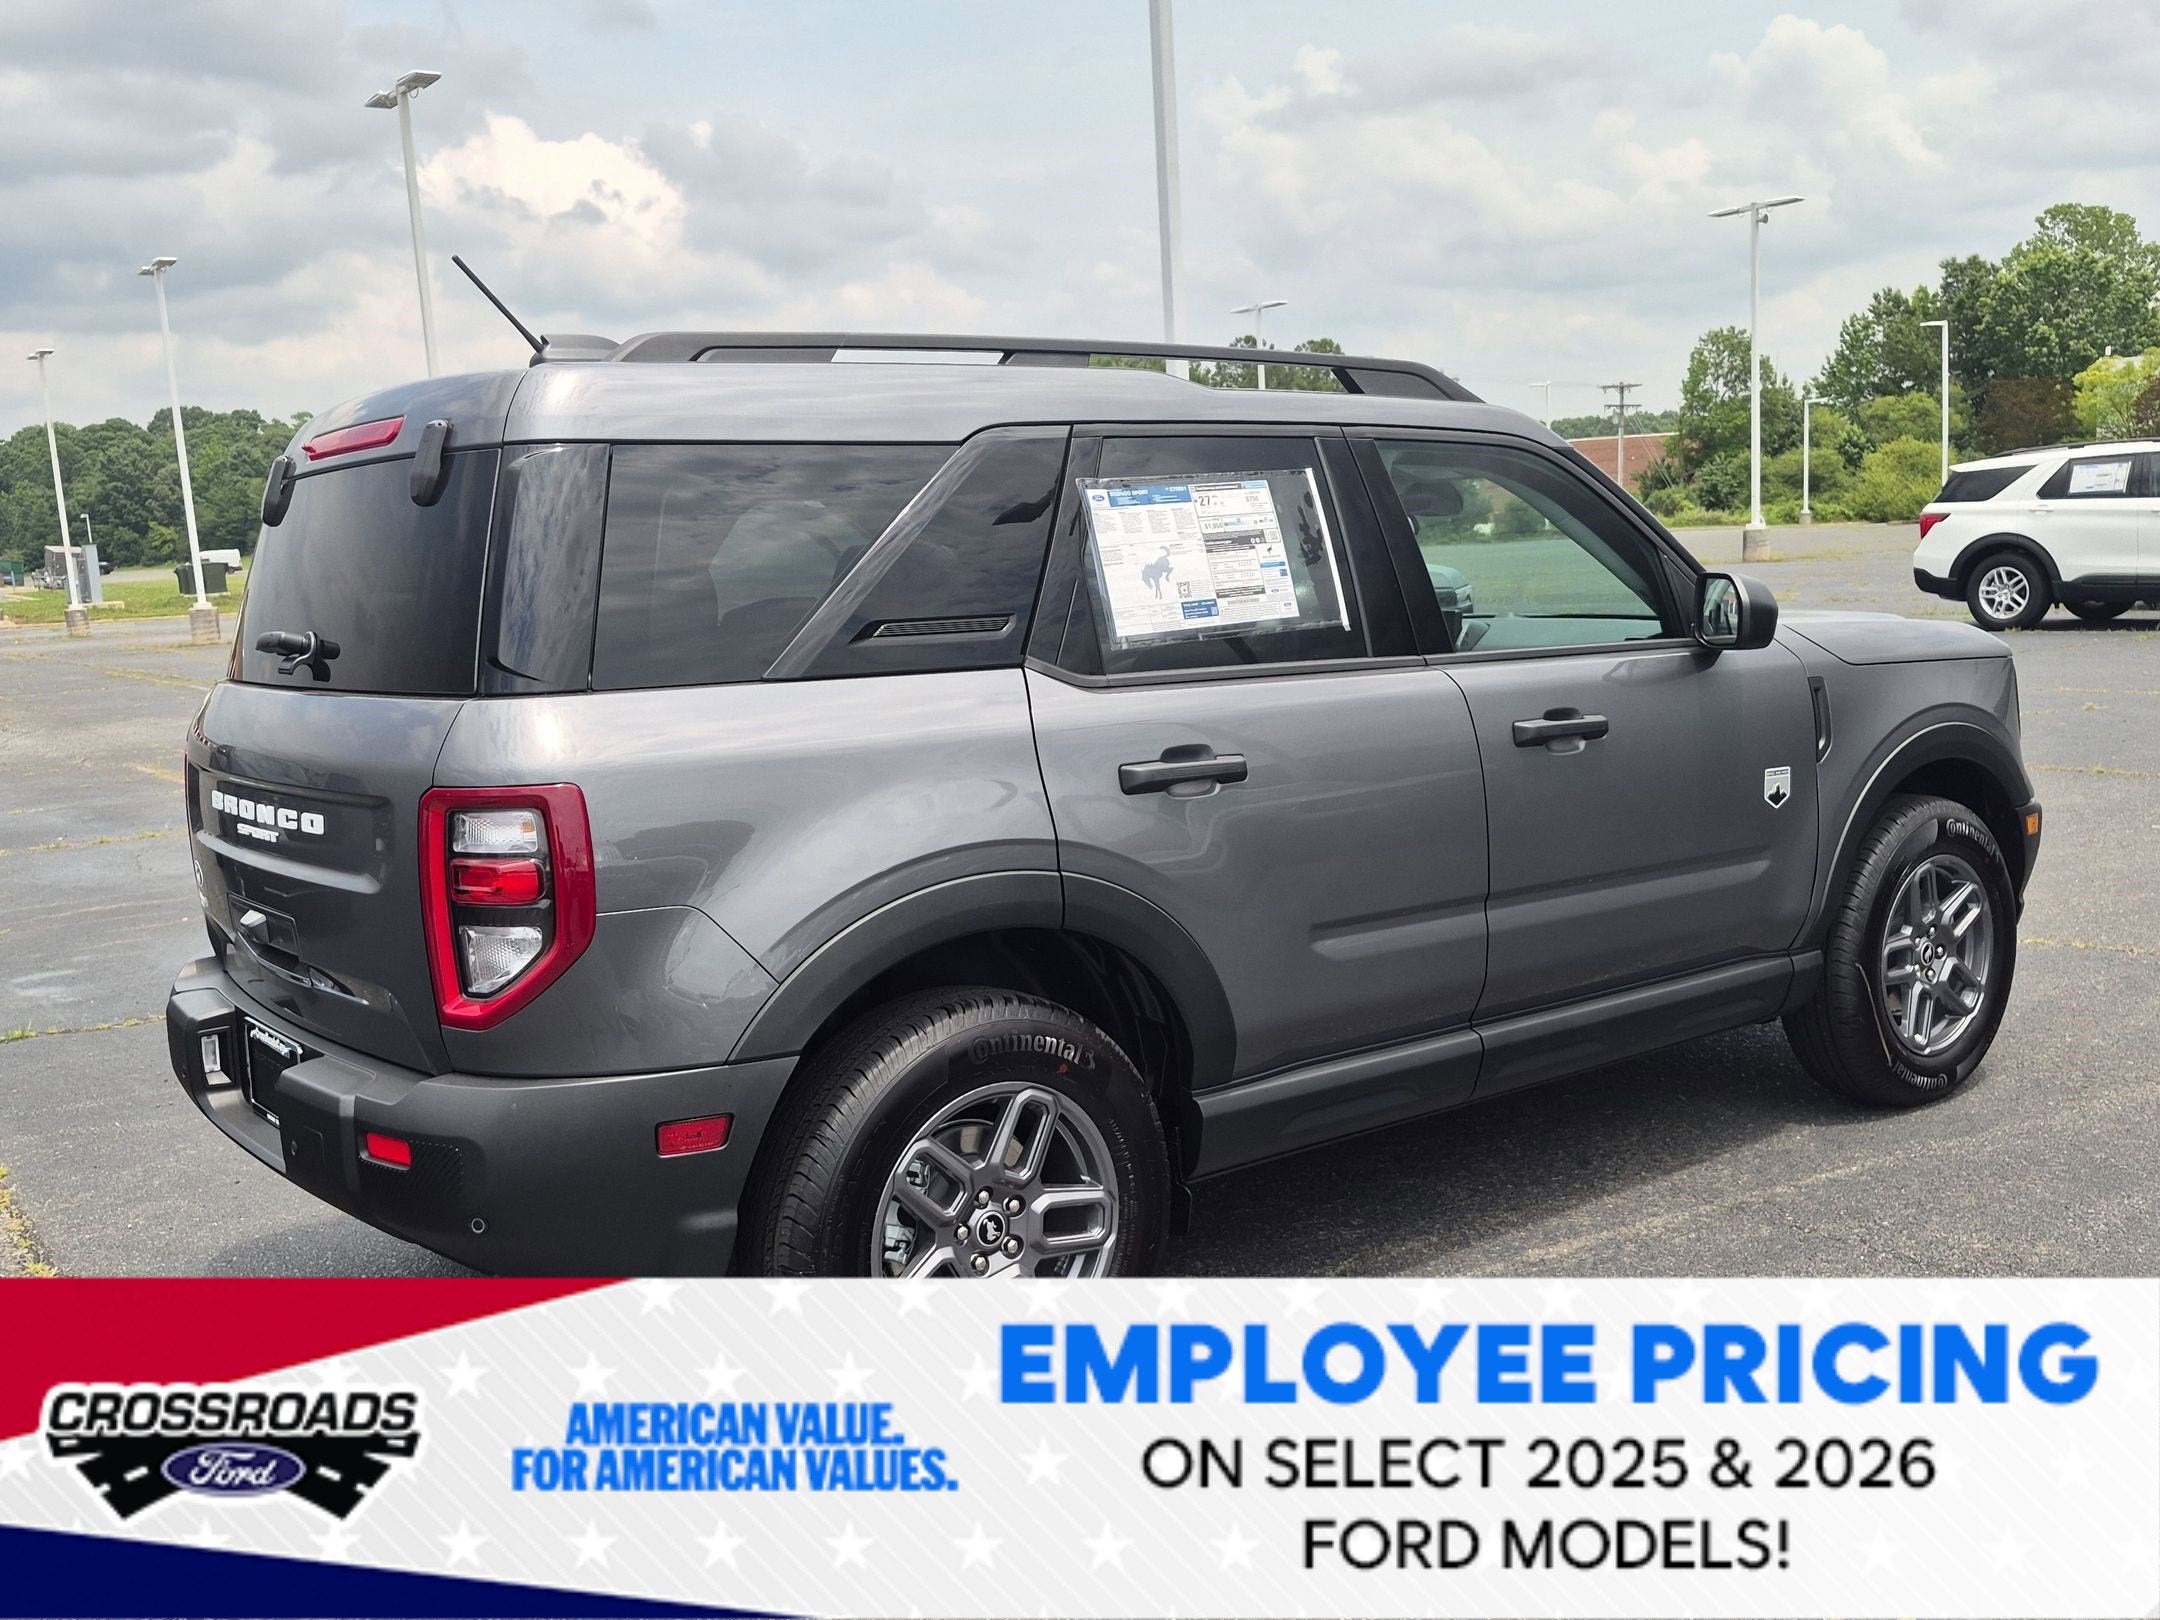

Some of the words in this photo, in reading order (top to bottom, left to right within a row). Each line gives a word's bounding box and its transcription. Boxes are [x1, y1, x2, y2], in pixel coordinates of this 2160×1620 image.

[1198, 495, 1211, 507] 27
[211, 789, 325, 835] BRONCO
[236, 822, 280, 843] SPORT
[1946, 818, 1996, 857] Continental
[968, 1031, 1081, 1065] Continental
